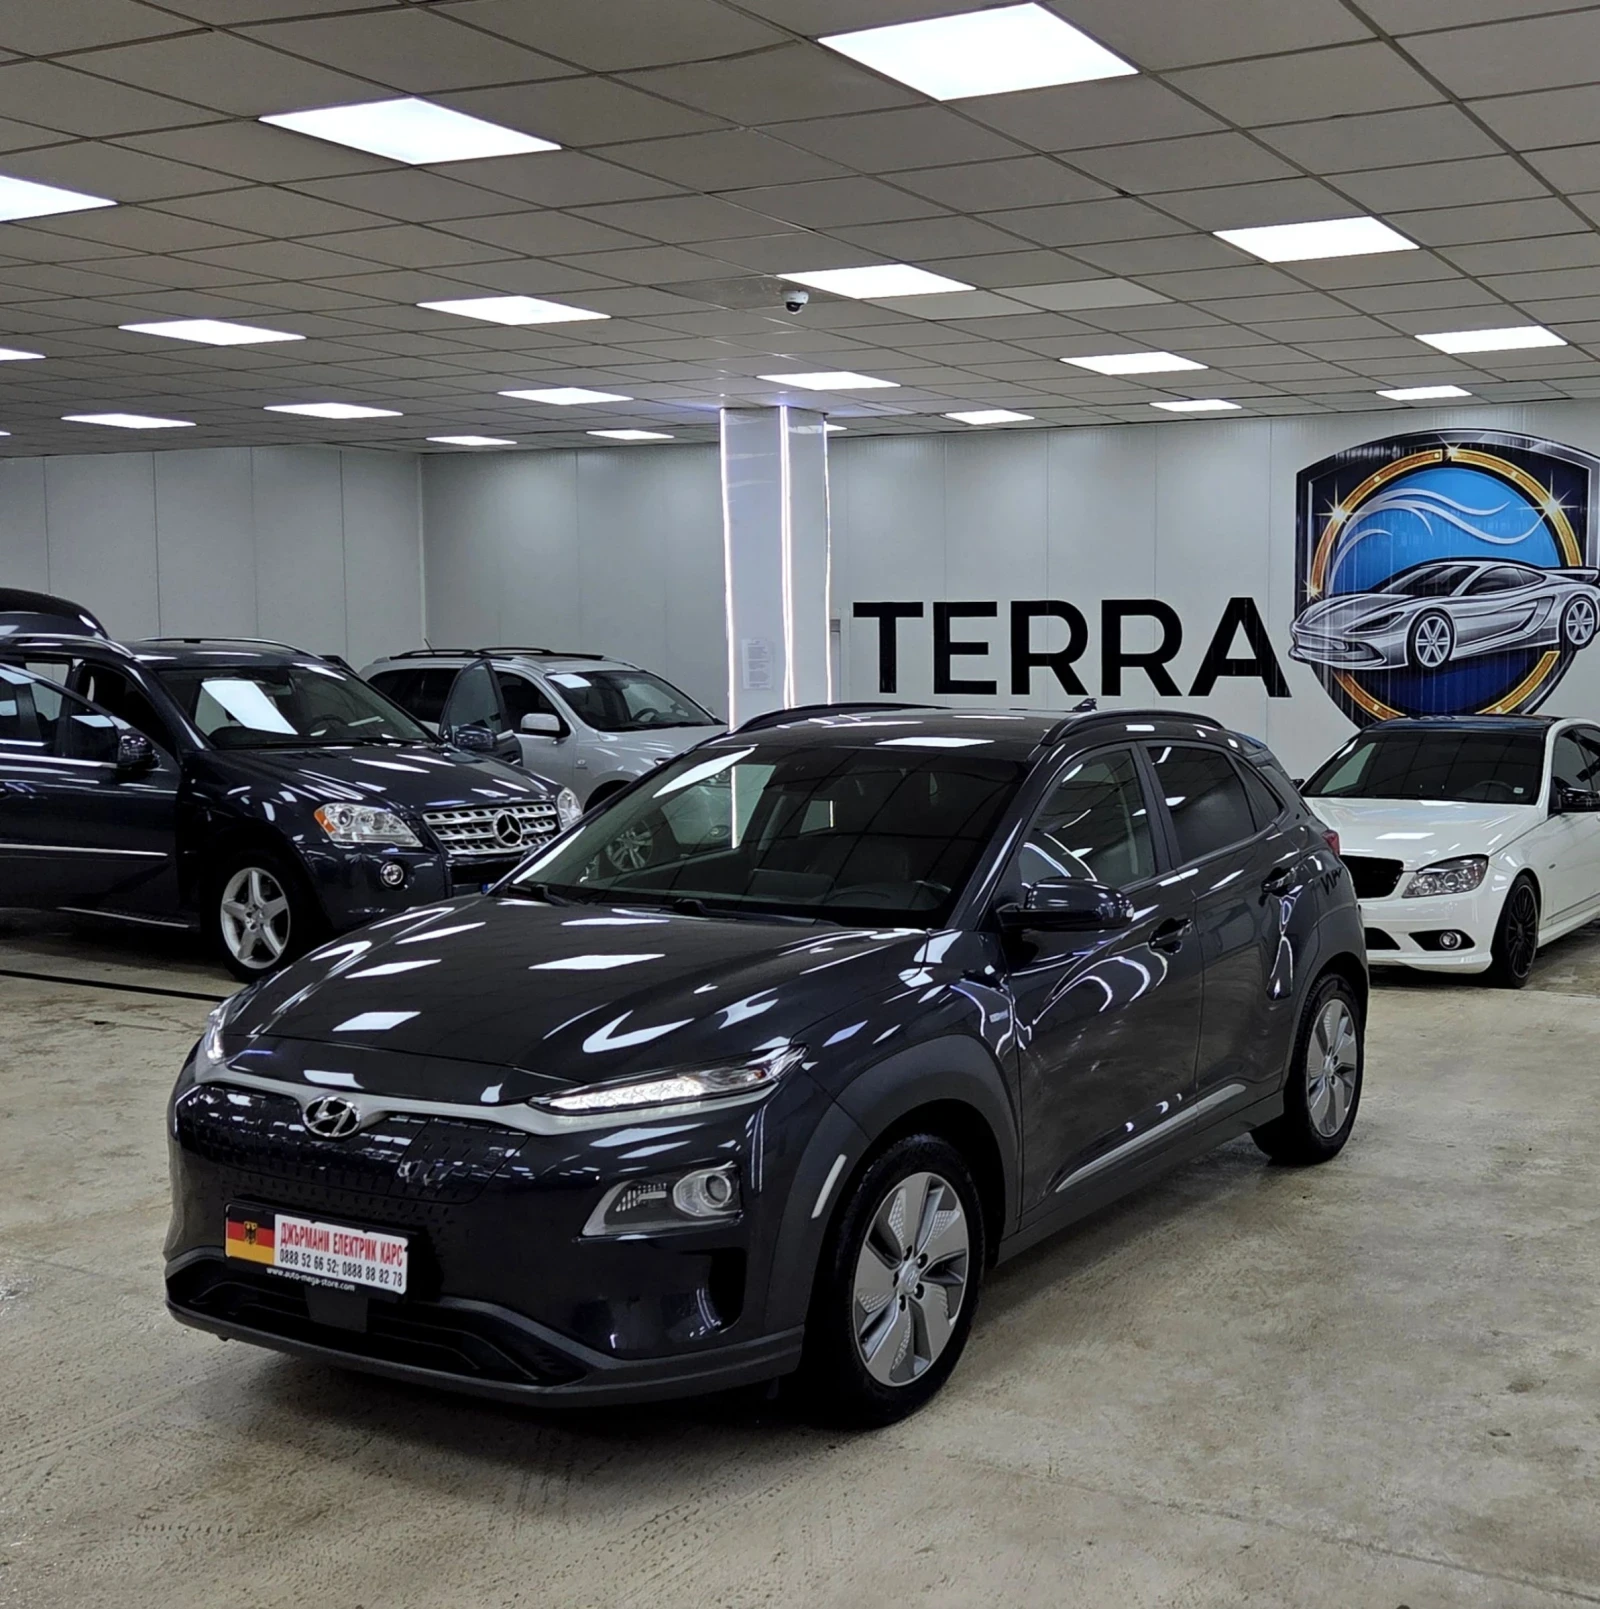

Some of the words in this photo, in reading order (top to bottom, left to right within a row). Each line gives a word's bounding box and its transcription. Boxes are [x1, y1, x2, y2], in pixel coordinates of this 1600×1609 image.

[853, 597, 1292, 698] TERRA
[280, 1222, 330, 1253] ДЖЪРМАНИ
[333, 1232, 377, 1262] ЕЛЕКТРИК
[380, 1240, 403, 1268] КАРС
[266, 1267, 356, 1292] www.auto-mega-store.com
[280, 1249, 299, 1266] 0888
[301, 1253, 312, 1268] 52
[313, 1255, 324, 1271] 66
[326, 1258, 339, 1277] 52;
[342, 1261, 363, 1279] 0888
[365, 1266, 376, 1282] 88
[379, 1268, 390, 1285] 82
[392, 1271, 403, 1288] 78
